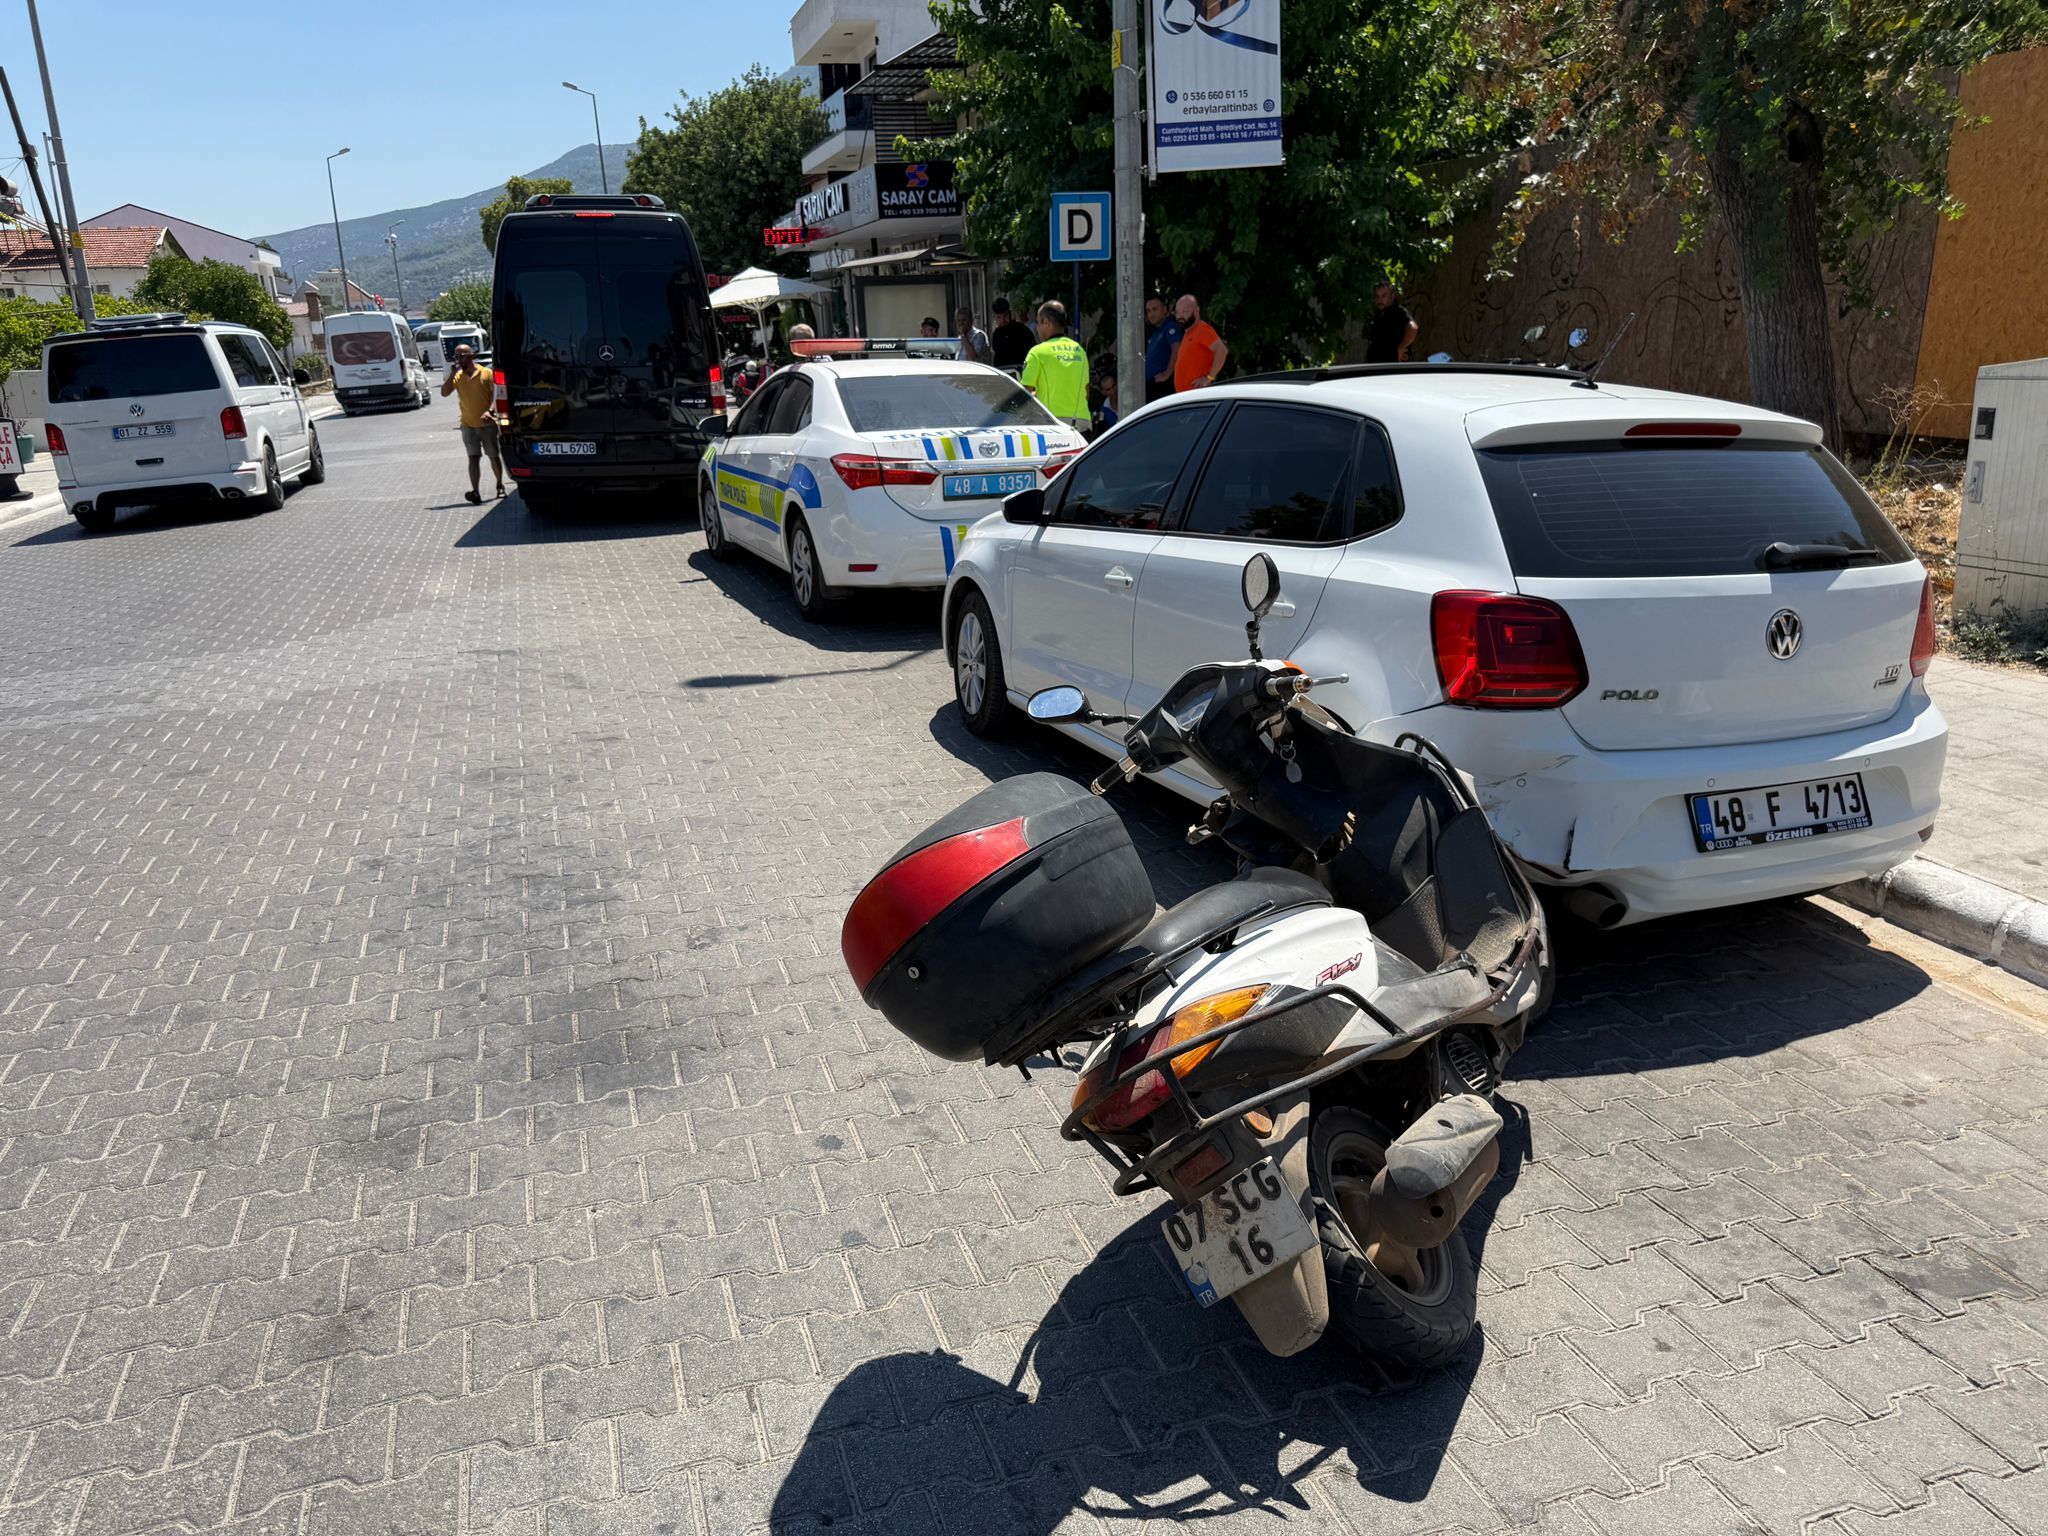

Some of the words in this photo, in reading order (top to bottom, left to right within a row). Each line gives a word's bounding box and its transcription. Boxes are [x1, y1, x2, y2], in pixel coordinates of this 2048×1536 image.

[1182, 92, 1189, 101] 0
[1190, 91, 1206, 101] 536
[1207, 90, 1224, 100] 660
[1225, 90, 1236, 99] 61
[1238, 89, 1249, 98] 15
[1182, 103, 1258, 115] erbaylaraltinbas
[801, 189, 826, 226] SARAY
[825, 183, 845, 218] CAM
[881, 190, 925, 206] SARAY
[928, 189, 957, 204] CAM
[1067, 209, 1093, 245] D
[119, 428, 130, 438] 01
[155, 424, 171, 434] 559
[538, 444, 552, 455] 34
[553, 444, 568, 454] TL
[569, 442, 596, 454] 6708
[953, 478, 970, 495] 48
[981, 477, 989, 493] A
[998, 474, 1033, 492] 8352
[1600, 689, 1659, 702] POLO
[1699, 823, 1713, 835] TR
[1713, 796, 1747, 835] 48
[1765, 791, 1781, 827] F
[1803, 780, 1863, 820] 4713
[1765, 827, 1814, 843] ÖZENİR
[1166, 1199, 1208, 1252] 07
[1211, 1162, 1283, 1225] SCG
[1228, 1224, 1275, 1276] 16
[1199, 1288, 1216, 1305] TR
